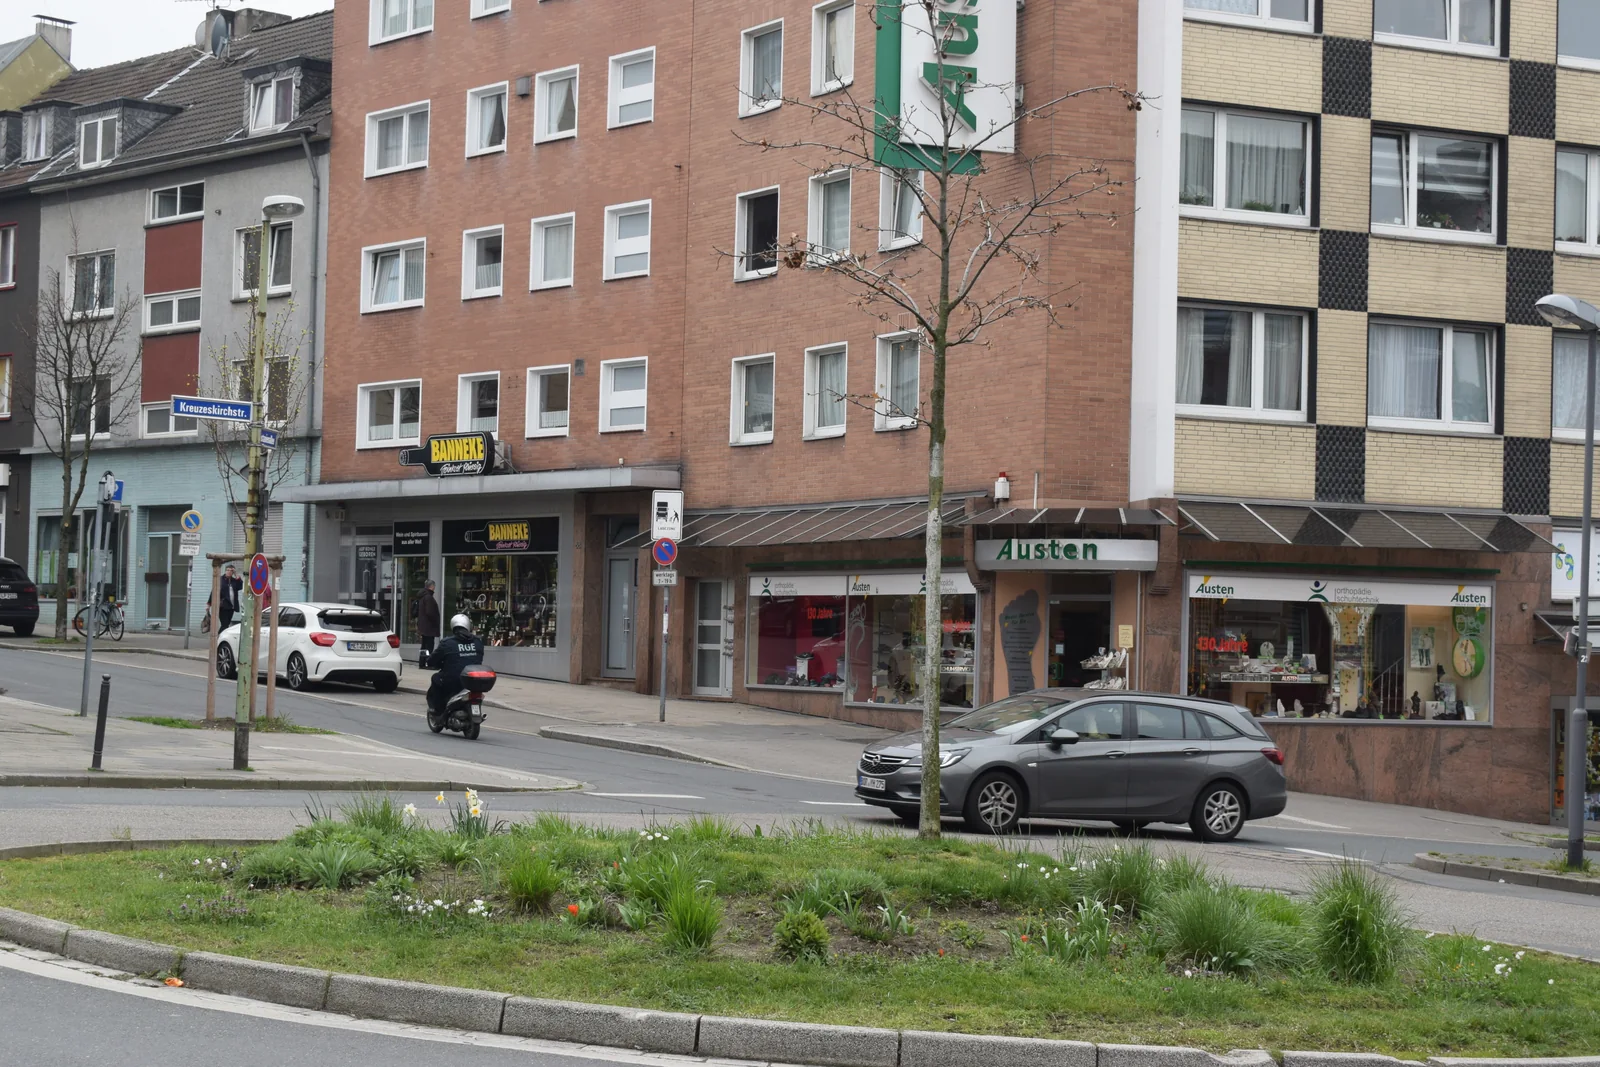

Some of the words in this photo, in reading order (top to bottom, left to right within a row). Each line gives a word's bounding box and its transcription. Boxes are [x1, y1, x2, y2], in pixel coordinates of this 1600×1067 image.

[919, 0, 979, 133] Au
[179, 401, 247, 418] Kreuzeskirchstr.
[430, 436, 485, 463] BANNEKE
[488, 523, 529, 541] BANNEKE
[996, 538, 1098, 560] Austen
[852, 582, 870, 592] Austen
[1196, 583, 1234, 595] Austen
[1336, 588, 1372, 596] orthopädie
[1450, 592, 1486, 604] Austen
[807, 608, 816, 619] 130
[816, 608, 833, 618] Jahre
[458, 643, 476, 652] RGE
[1198, 636, 1216, 650] 130
[1218, 636, 1248, 652] Jahre
[876, 780, 885, 789] 275
